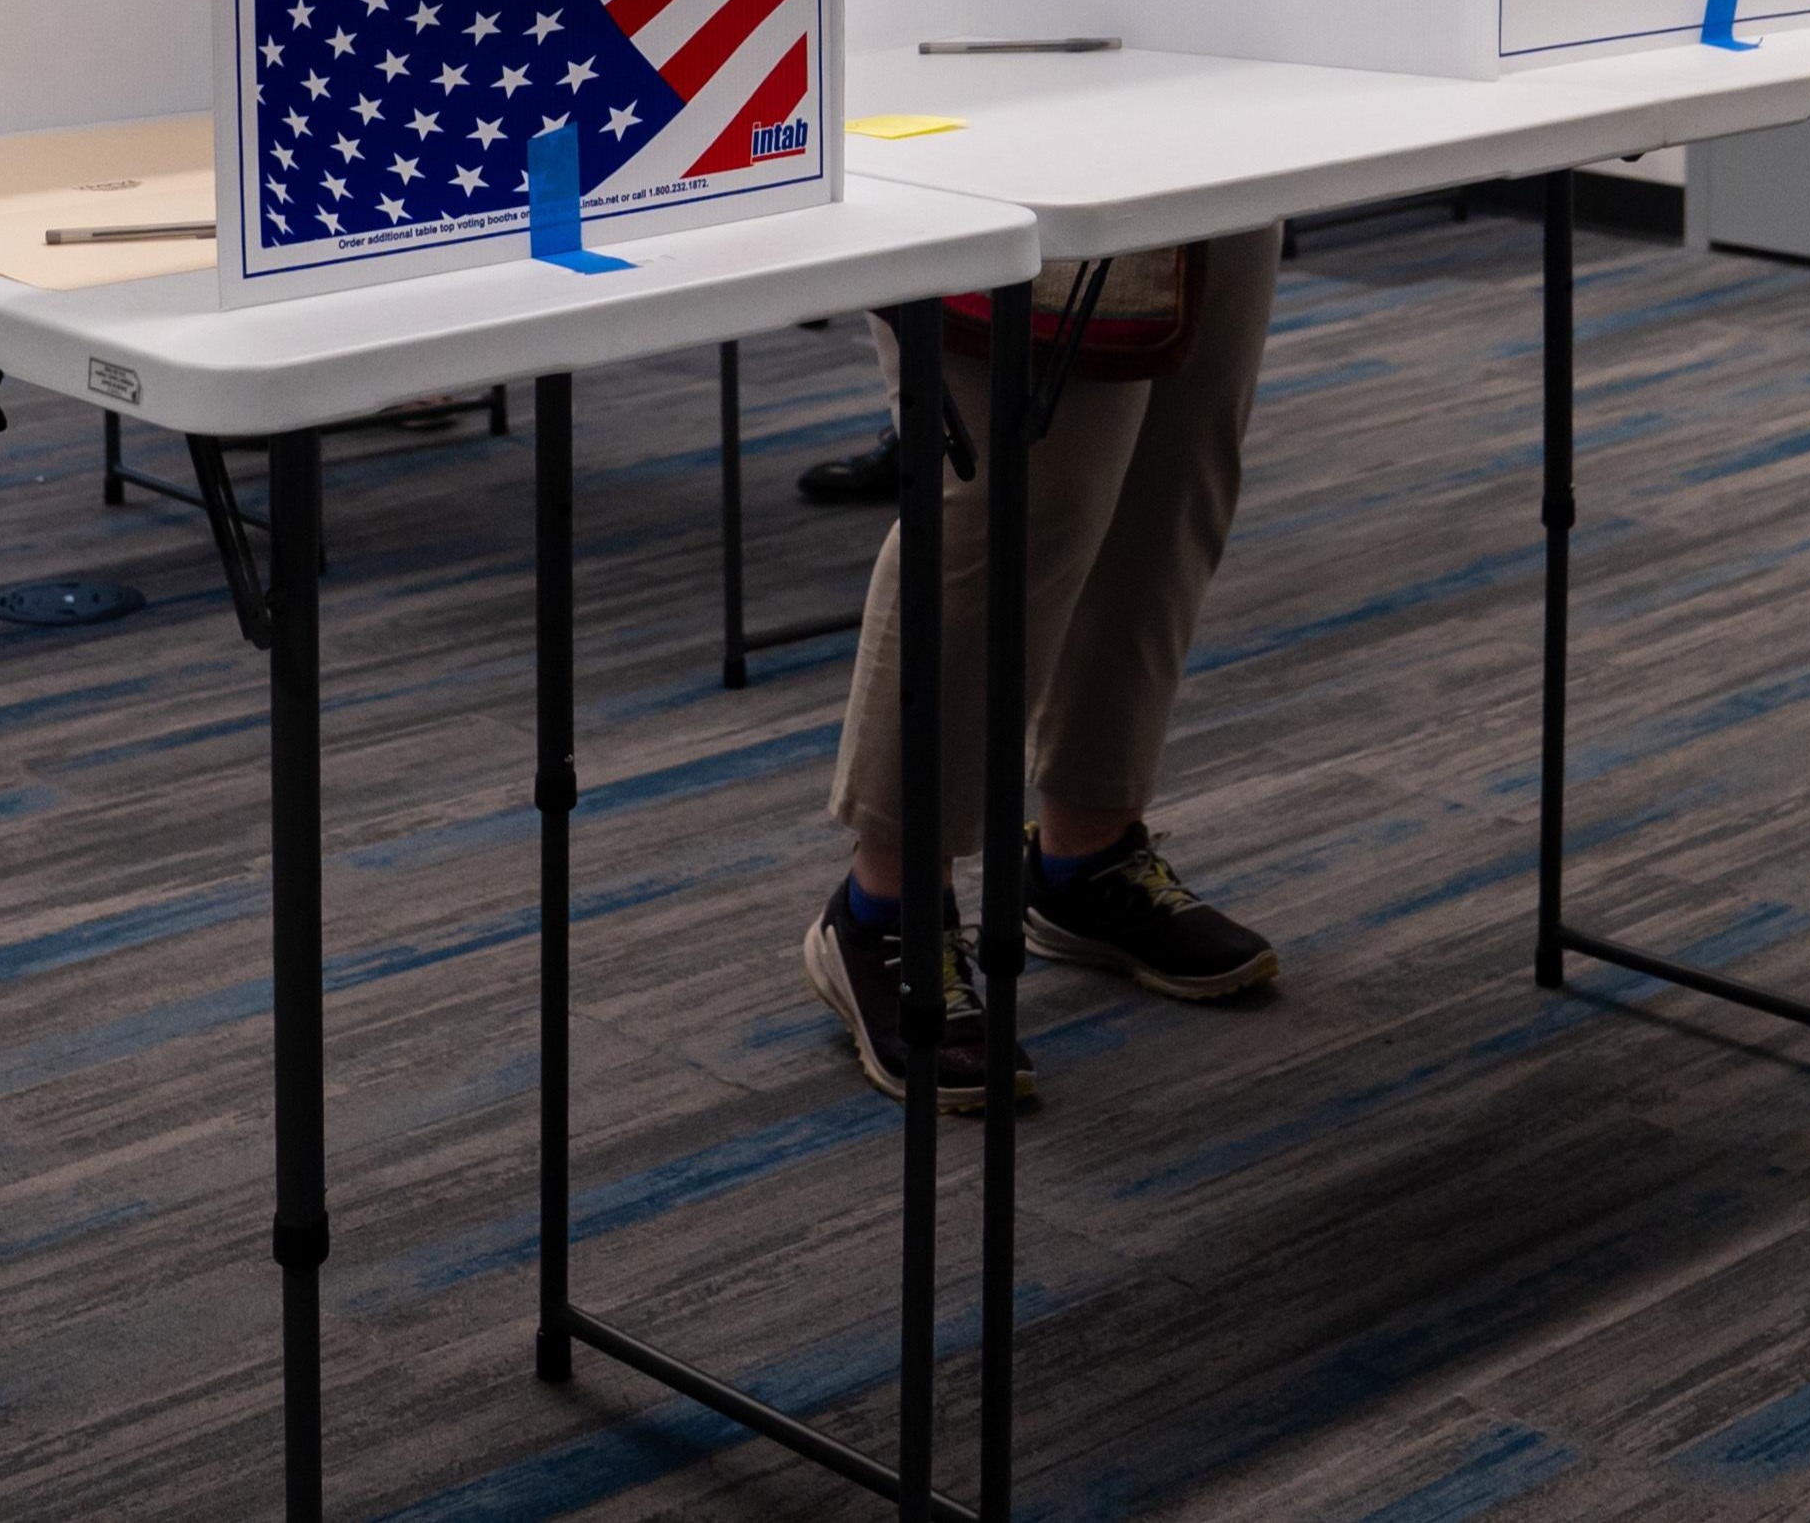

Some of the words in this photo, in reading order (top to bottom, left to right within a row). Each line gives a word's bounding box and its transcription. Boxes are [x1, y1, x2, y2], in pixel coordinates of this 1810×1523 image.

[752, 118, 809, 156] intab
[338, 238, 365, 250] Order
[367, 228, 413, 245] additional
[415, 225, 438, 237] table
[440, 222, 455, 233] top
[457, 217, 485, 230] voting
[487, 211, 517, 225] booths
[580, 196, 619, 209] .intab.net
[621, 194, 630, 202] or
[632, 189, 647, 200] call
[649, 178, 709, 197] 1.800.232.1872.
